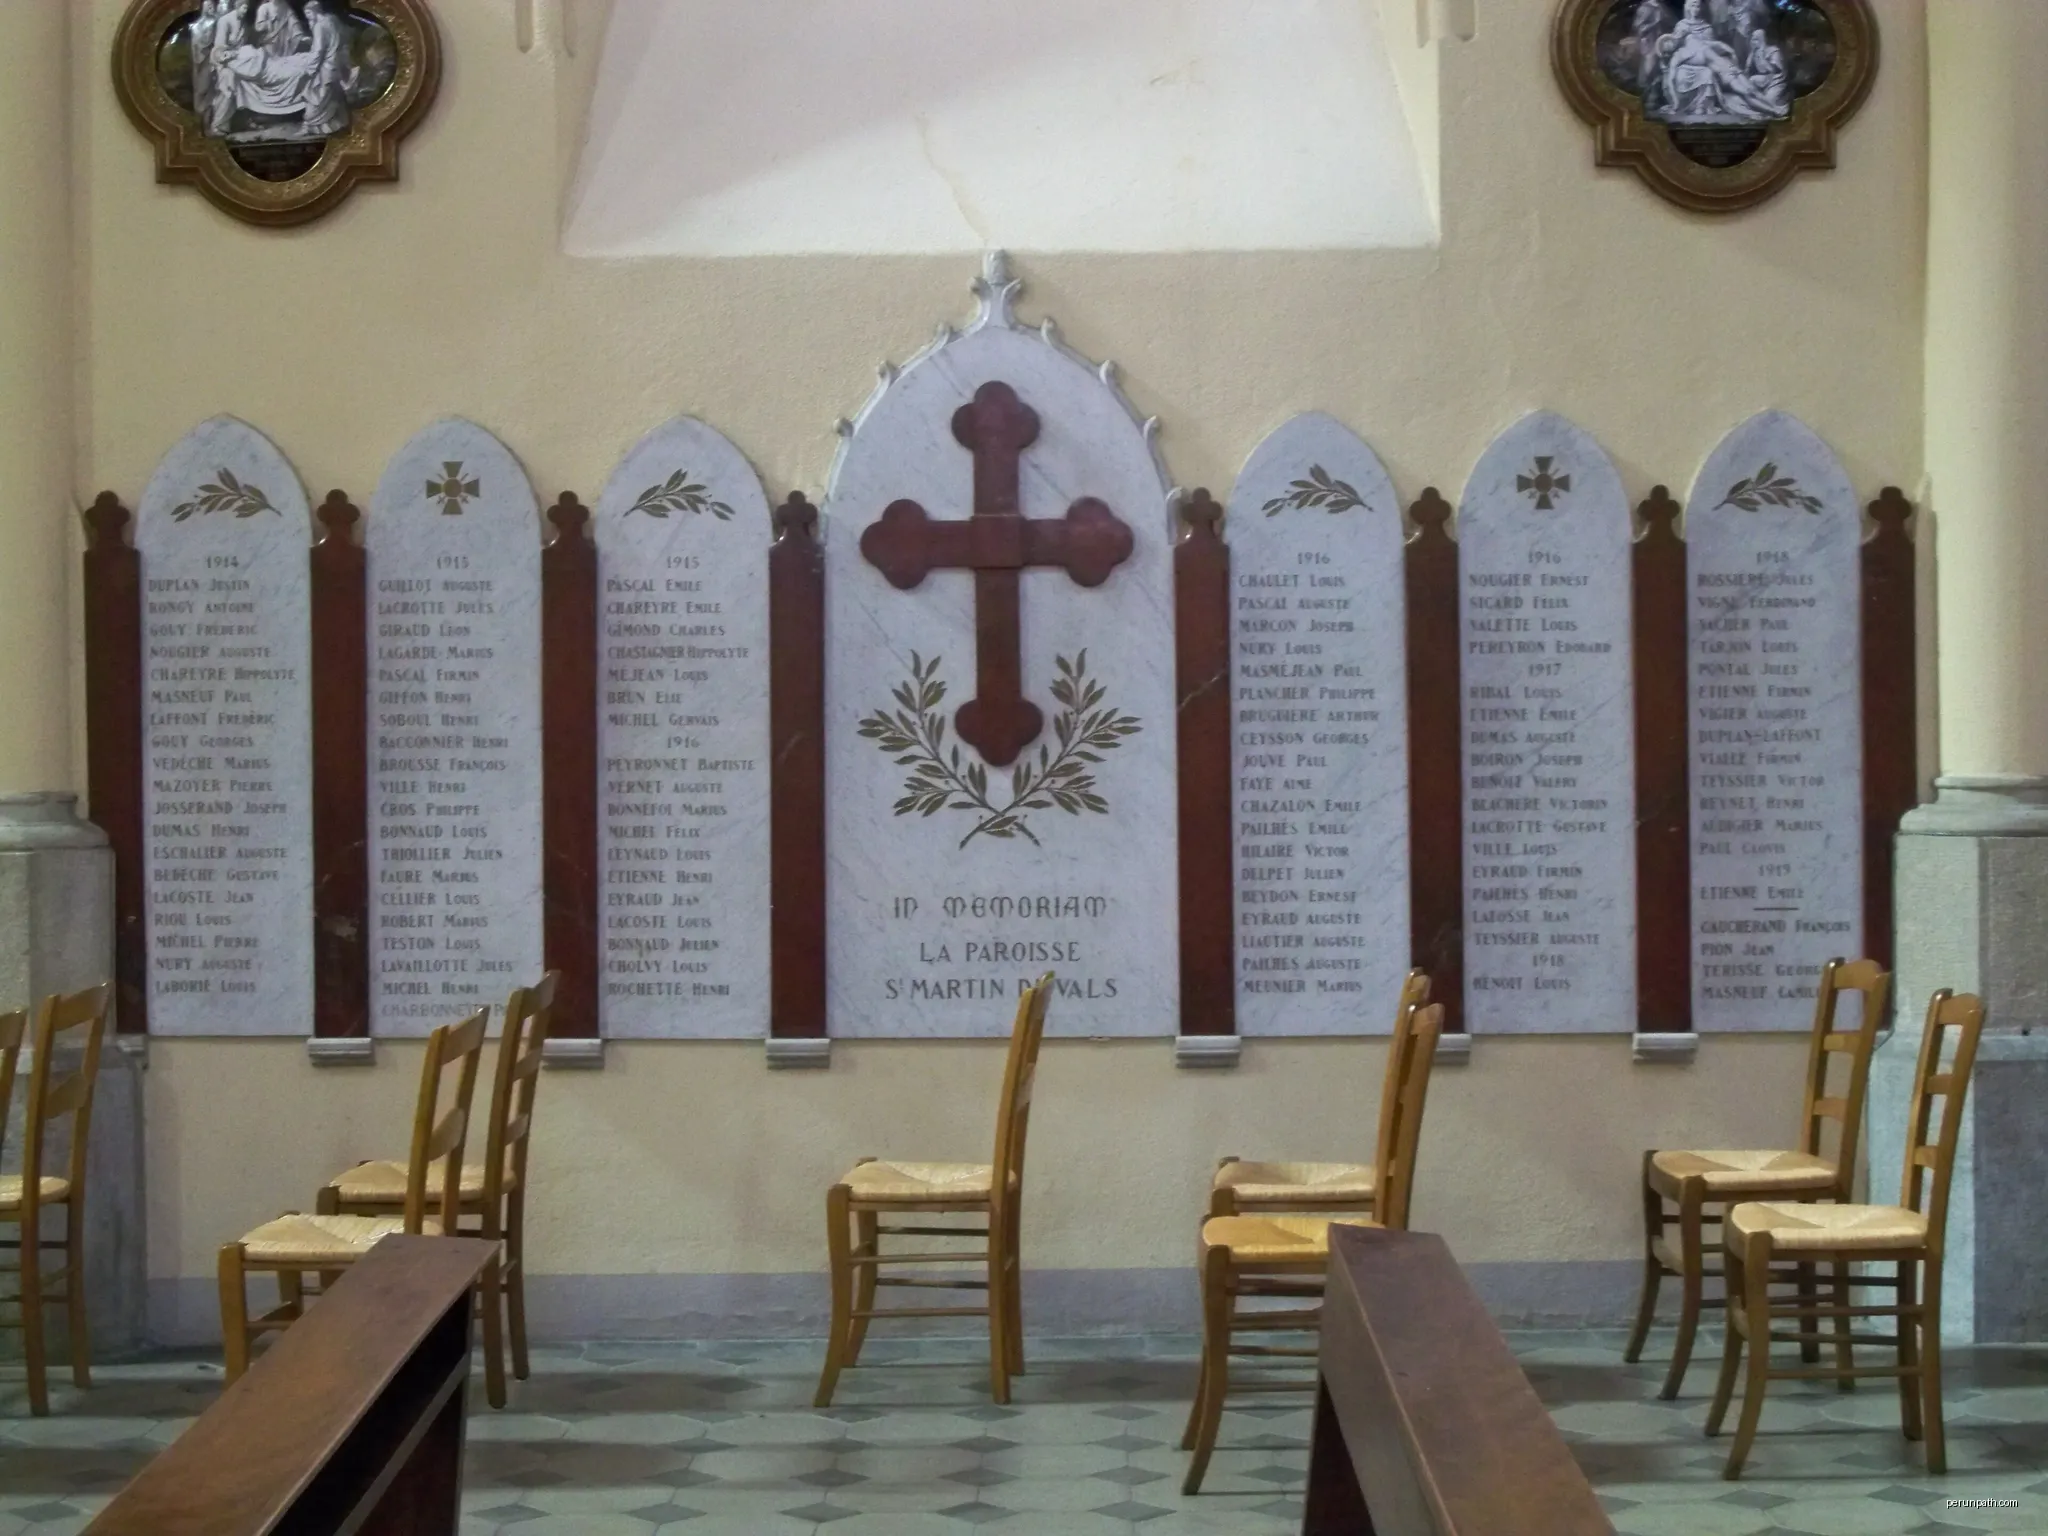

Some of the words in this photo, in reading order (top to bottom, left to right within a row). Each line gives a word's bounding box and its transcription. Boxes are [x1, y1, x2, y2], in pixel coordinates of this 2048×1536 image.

[894, 896, 918, 919] IN
[942, 896, 1107, 919] MEMORIAM
[919, 942, 951, 962] LA
[966, 942, 1081, 962] PAROISSE
[910, 979, 1004, 1000] MARTIN
[1055, 979, 1118, 1000] VALS
